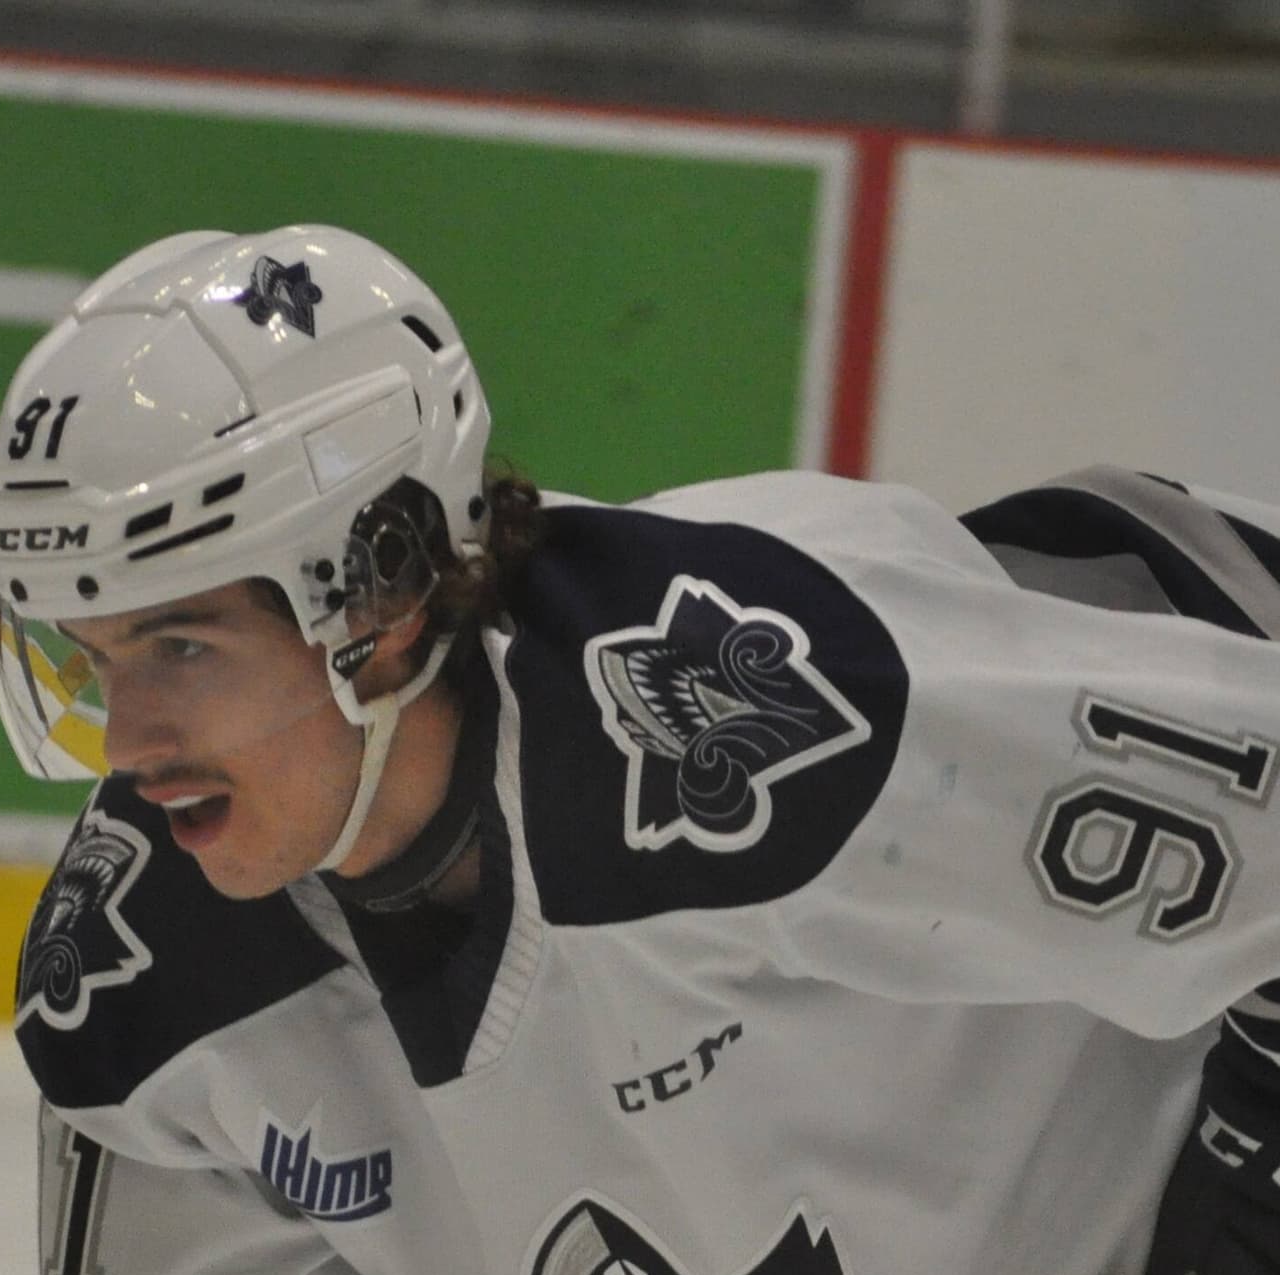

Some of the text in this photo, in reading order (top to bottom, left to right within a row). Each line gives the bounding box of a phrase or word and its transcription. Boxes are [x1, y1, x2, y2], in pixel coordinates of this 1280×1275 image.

[8, 394, 80, 460] 91
[335, 640, 376, 668] CCM
[611, 1020, 743, 1113] CCM
